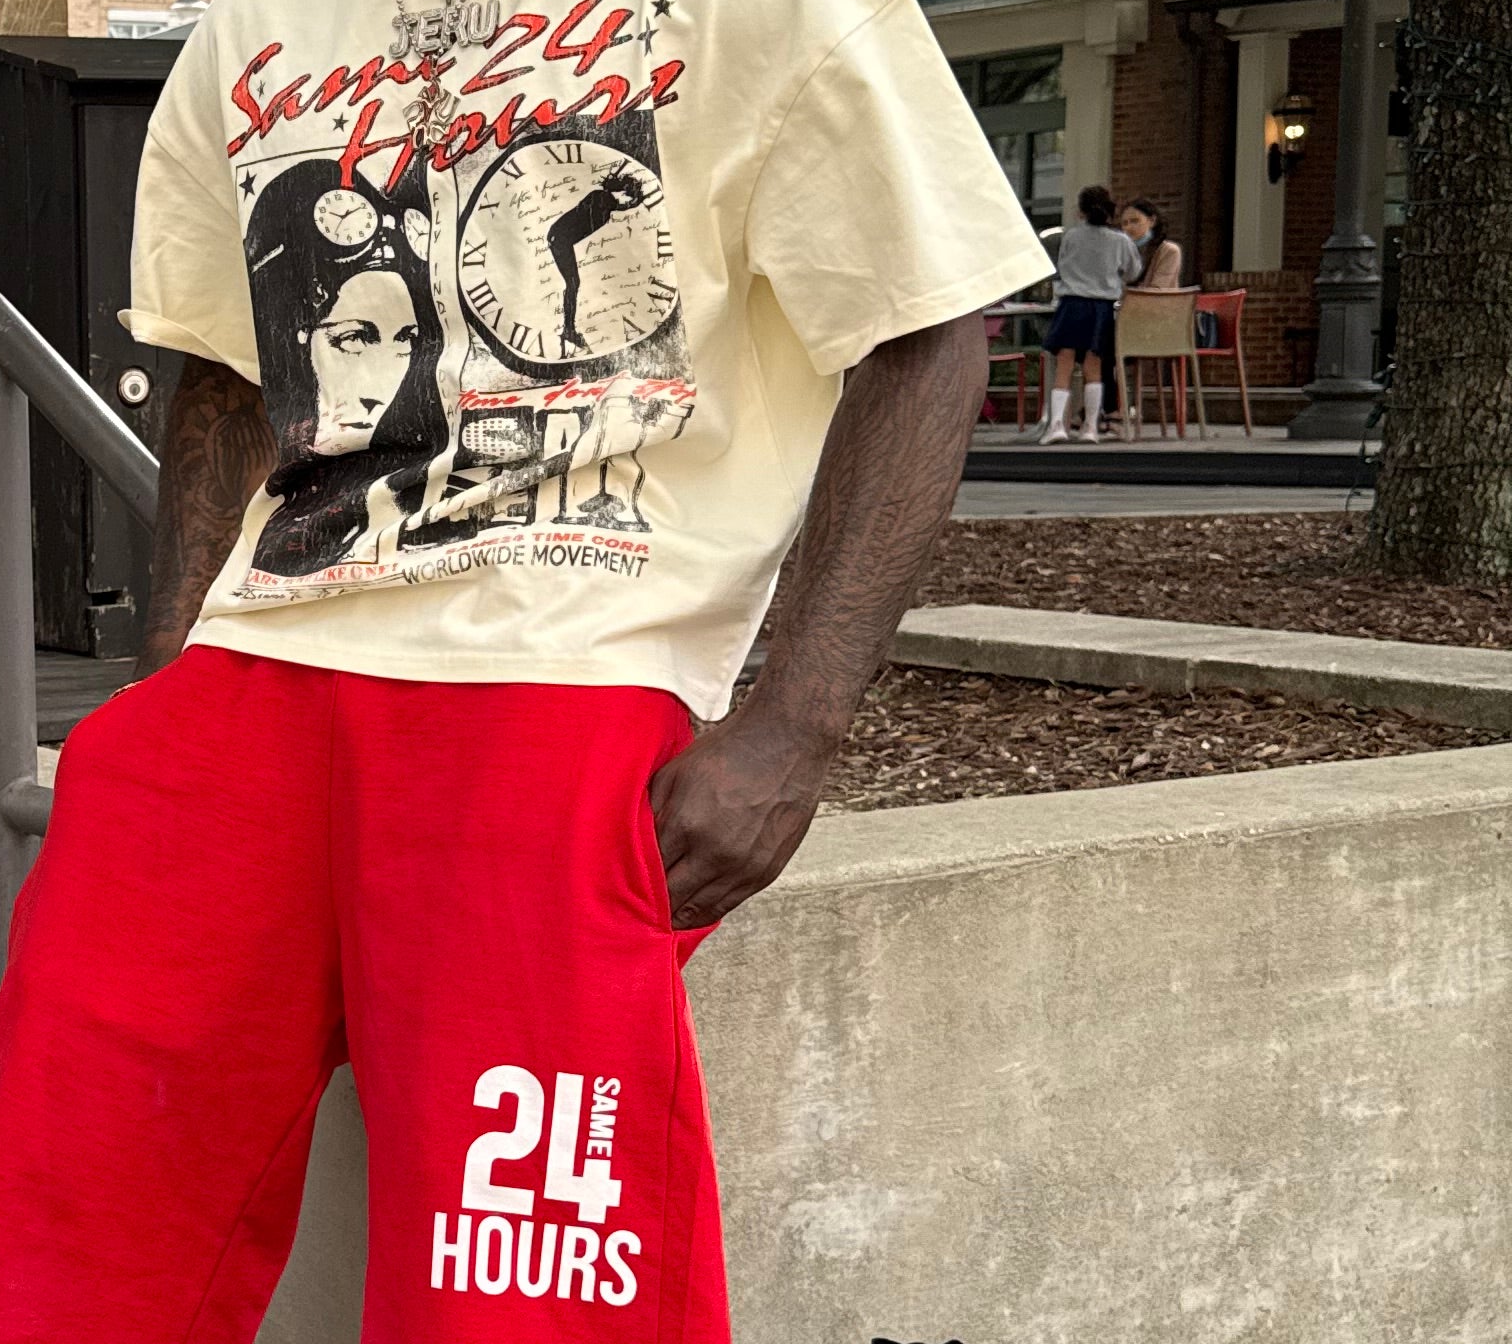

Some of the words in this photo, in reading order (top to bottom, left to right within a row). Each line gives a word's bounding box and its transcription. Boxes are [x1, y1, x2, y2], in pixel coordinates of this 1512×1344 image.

[401, 544, 525, 585] WORLDWIDE
[530, 544, 650, 579] MOVEMENT
[532, 532, 585, 543] TIME
[462, 1065, 622, 1224] 24
[586, 1076, 621, 1157] SAME
[430, 1211, 641, 1306] HOURS
